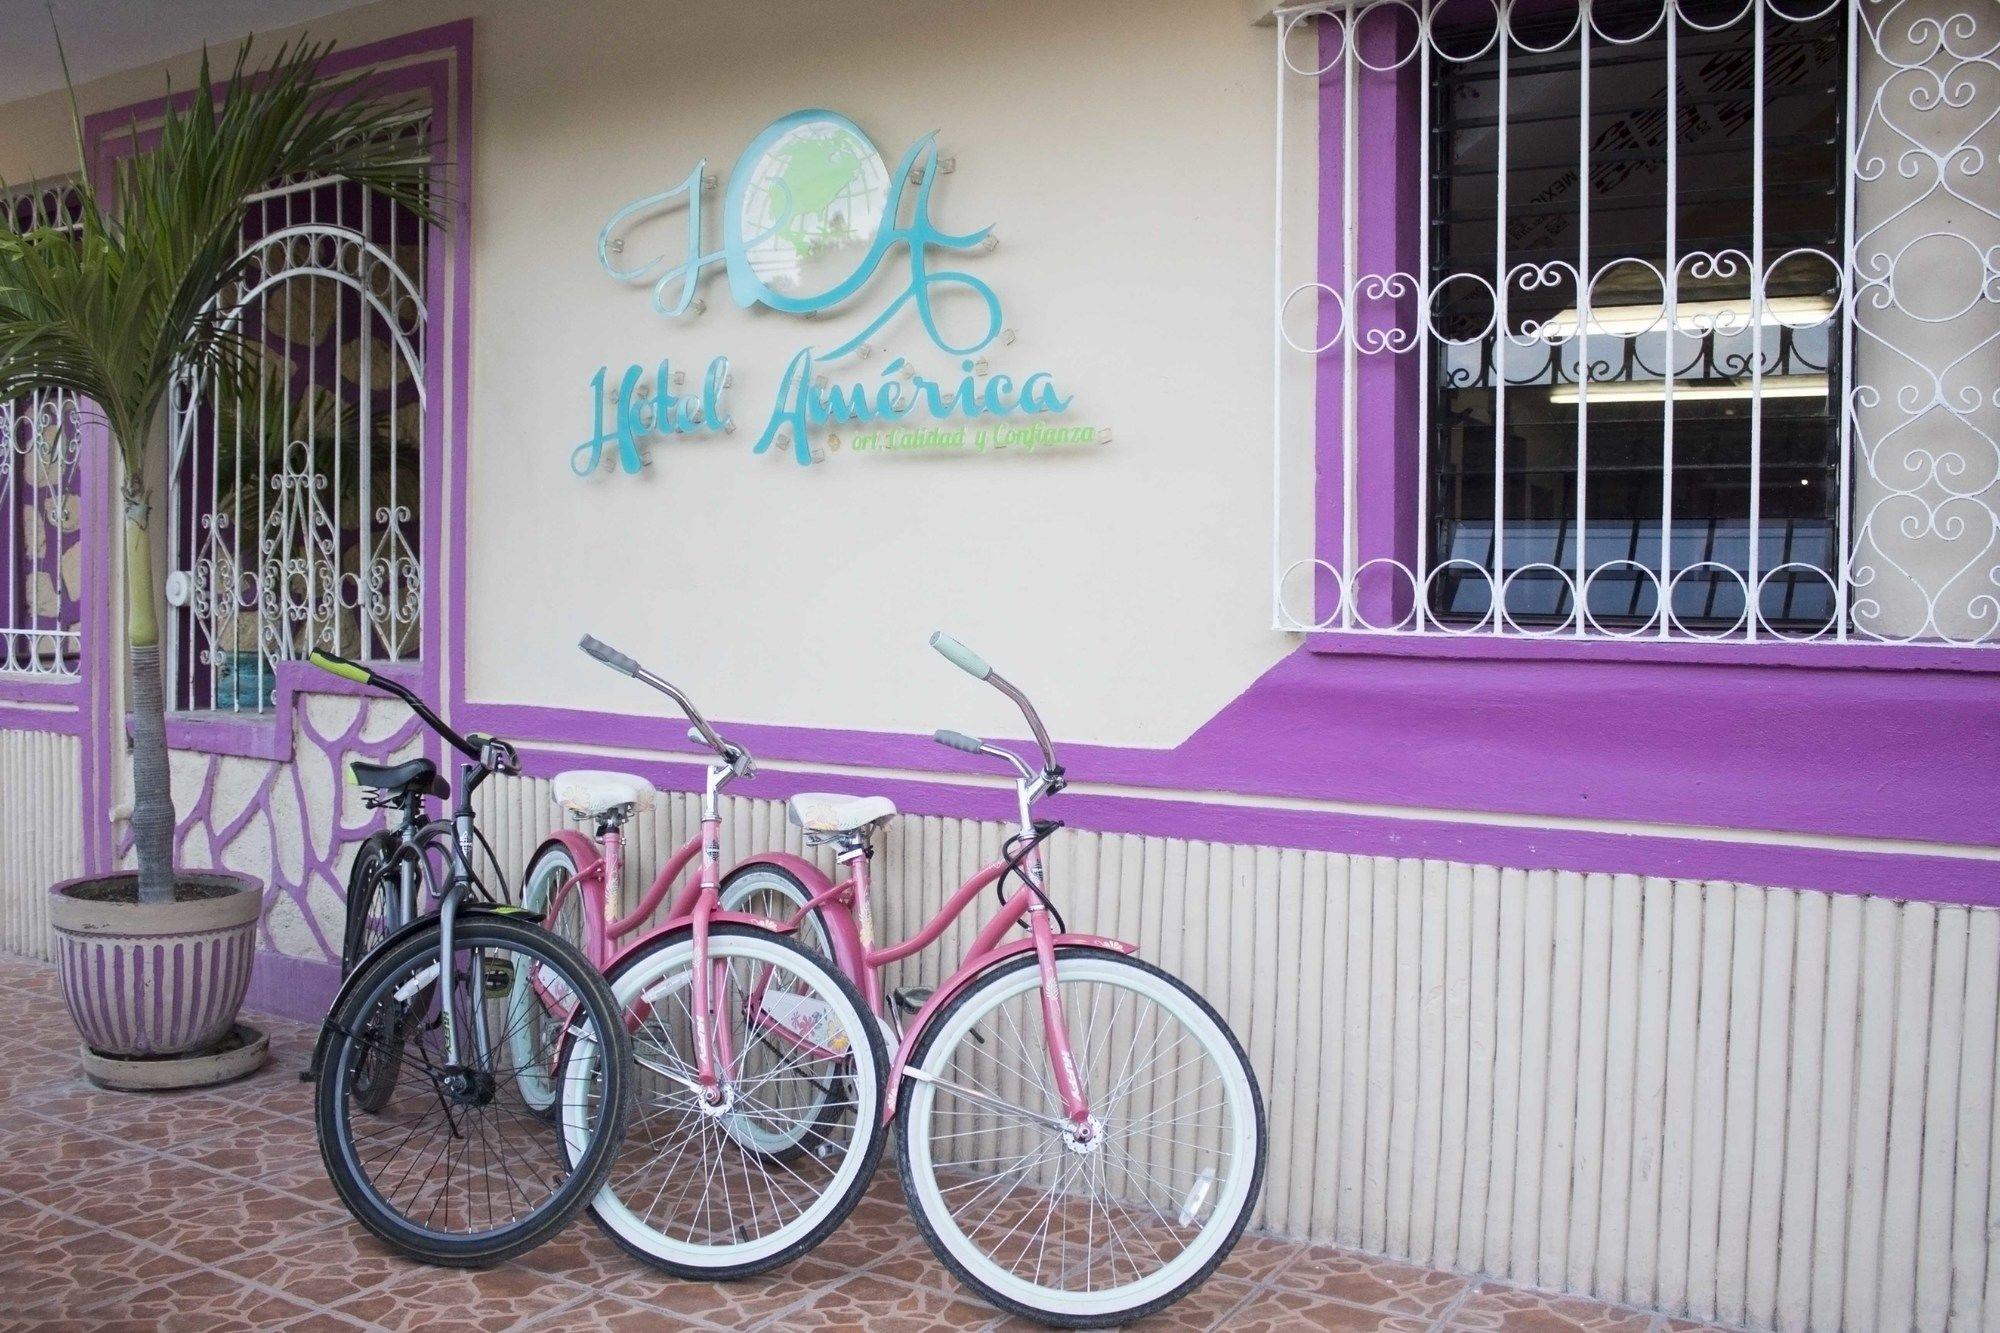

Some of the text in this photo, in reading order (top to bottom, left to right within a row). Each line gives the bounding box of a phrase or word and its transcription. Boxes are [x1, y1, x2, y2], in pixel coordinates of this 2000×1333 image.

[570, 346, 1075, 477] Hotel América
[889, 427, 966, 450] Calidad
[975, 430, 986, 453] y
[991, 421, 1095, 453] Confianza
